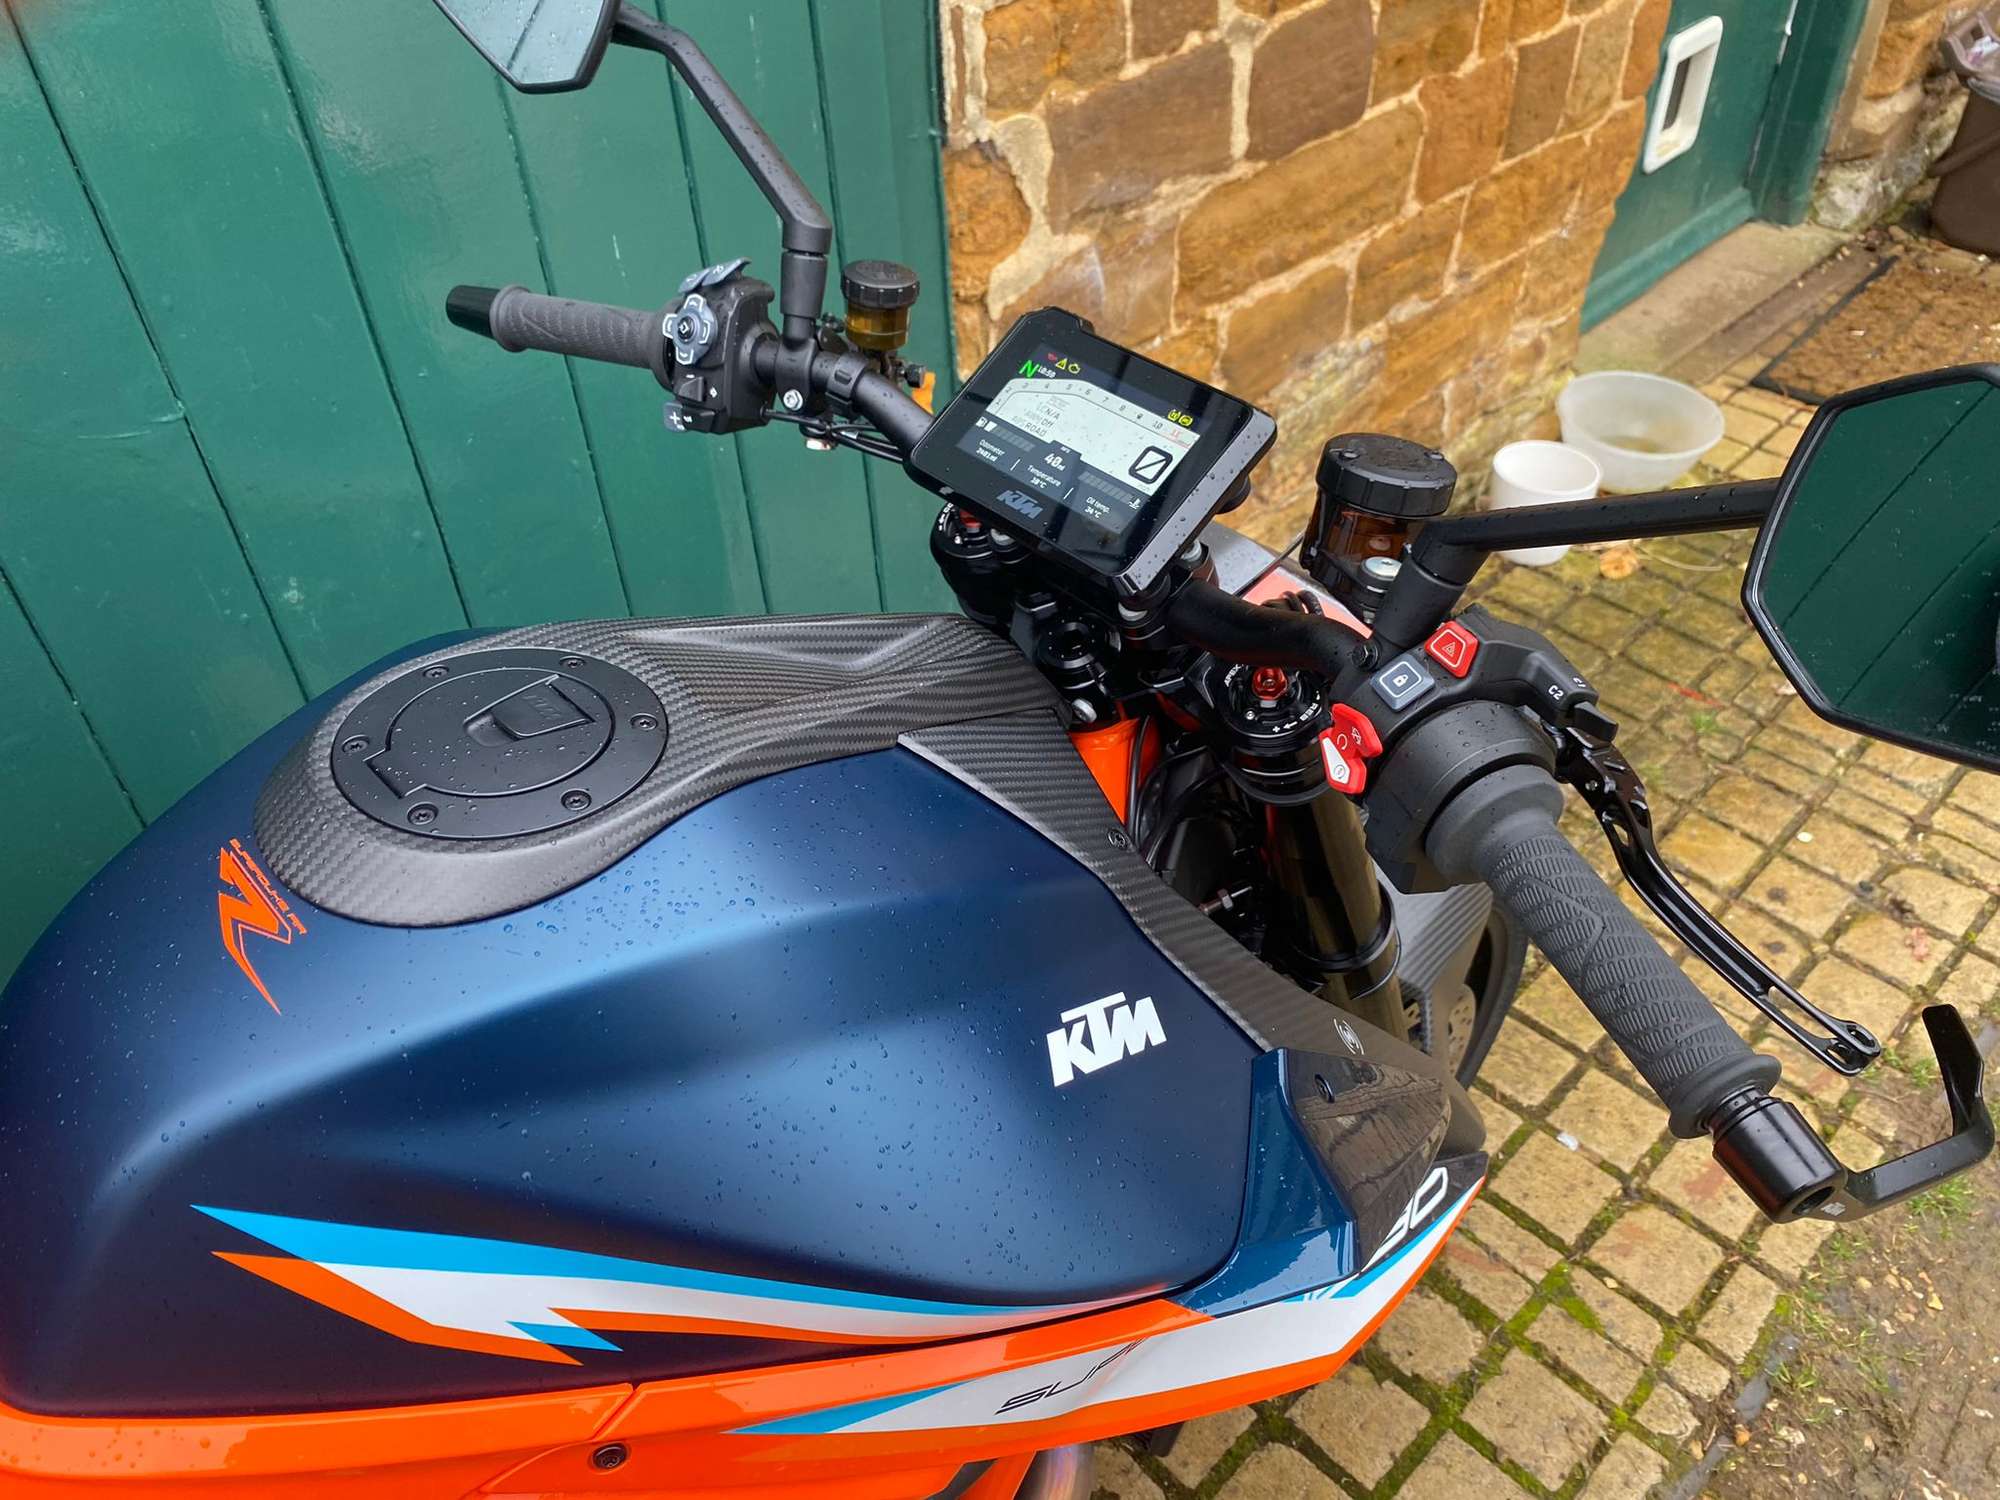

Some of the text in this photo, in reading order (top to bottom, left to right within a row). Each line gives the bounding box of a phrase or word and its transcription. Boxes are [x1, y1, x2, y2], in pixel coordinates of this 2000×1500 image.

[1019, 360, 1040, 378] N
[1025, 422, 1049, 437] ROAD
[979, 438, 1006, 456] Odometer
[1027, 464, 1062, 487] Temperature
[996, 490, 1044, 519] KTM
[1548, 684, 1564, 700] C2
[1046, 991, 1167, 1087] KTM
